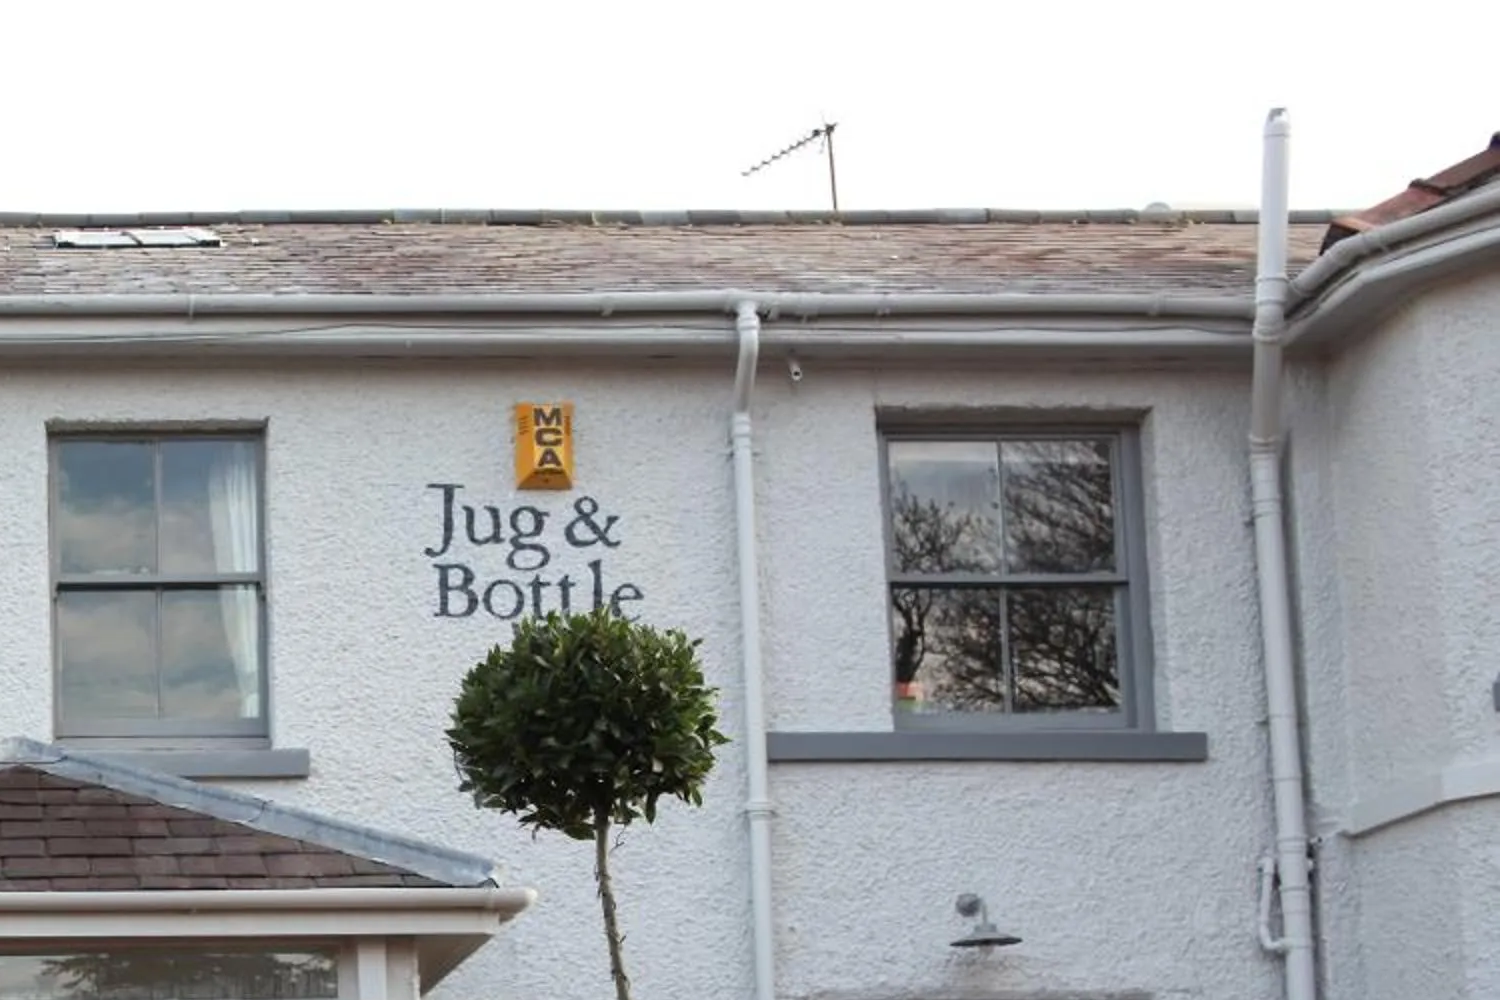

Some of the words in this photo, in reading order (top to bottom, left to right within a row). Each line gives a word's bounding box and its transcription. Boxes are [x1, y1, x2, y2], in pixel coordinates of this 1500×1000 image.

[533, 407, 563, 468] MCA
[424, 483, 550, 570] Jug
[564, 496, 622, 548] &
[432, 559, 645, 622] Bottle
